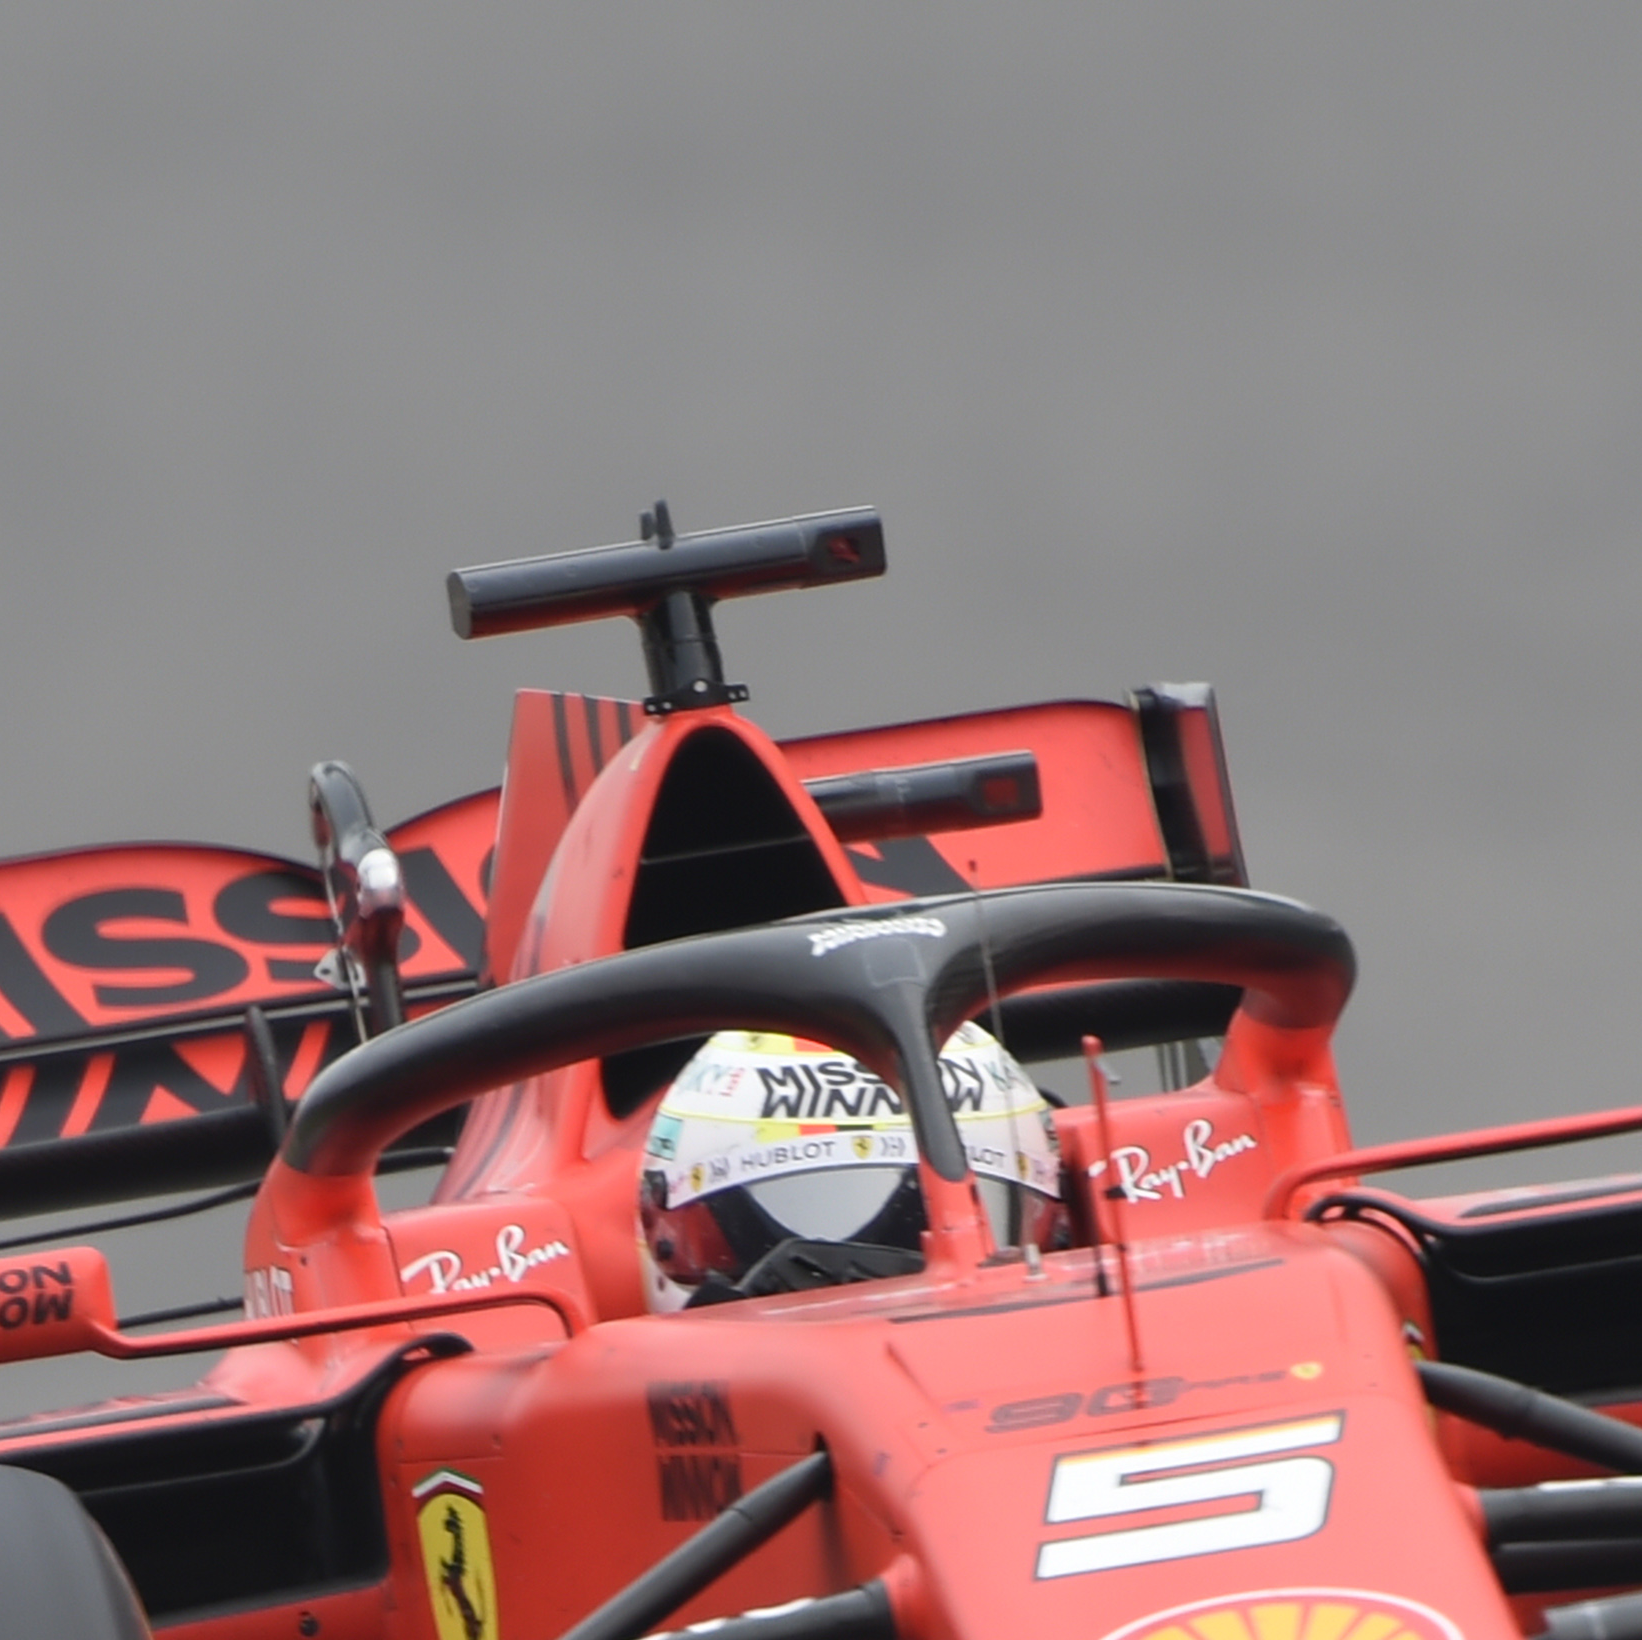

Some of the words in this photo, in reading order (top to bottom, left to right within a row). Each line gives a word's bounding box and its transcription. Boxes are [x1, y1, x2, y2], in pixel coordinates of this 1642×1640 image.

[758, 1057, 984, 1095] MISSN
[761, 1079, 981, 1118] WINNW
[741, 1140, 836, 1171] HUBLOT
[1088, 1119, 1257, 1204] Ray-Ban
[1033, 1409, 1346, 1581] 5
